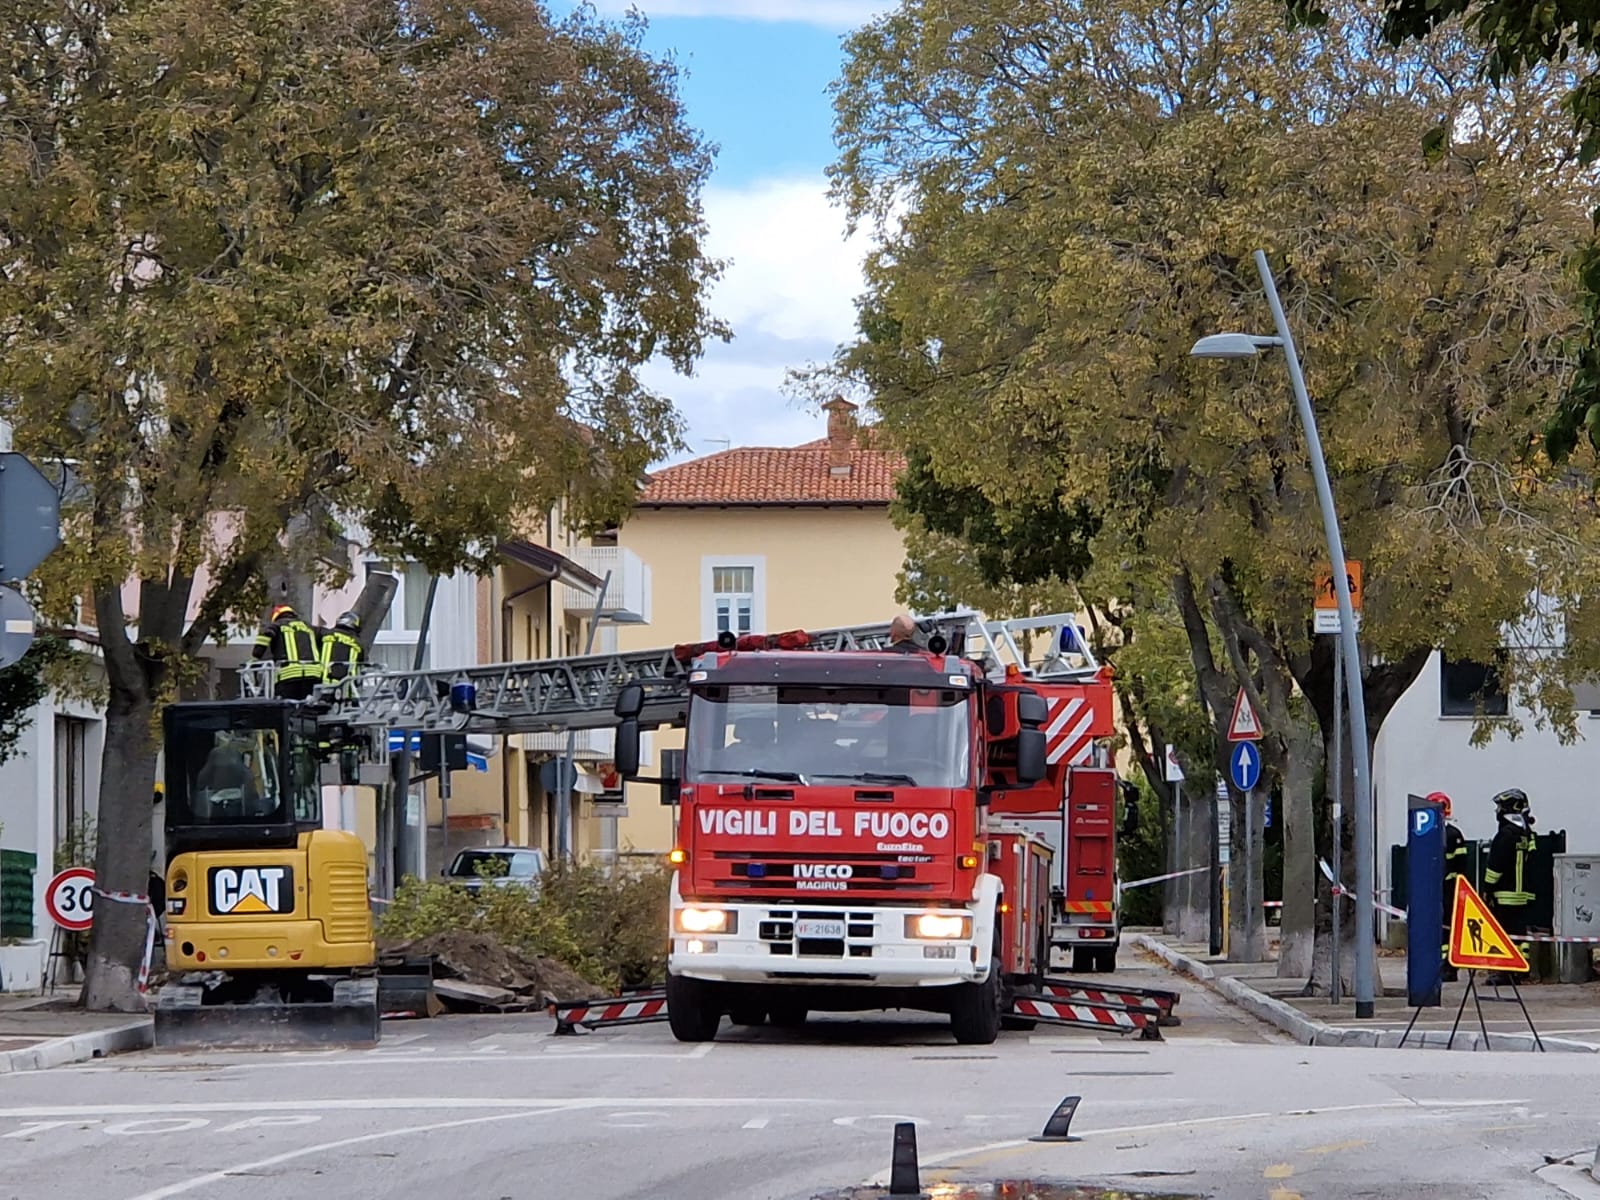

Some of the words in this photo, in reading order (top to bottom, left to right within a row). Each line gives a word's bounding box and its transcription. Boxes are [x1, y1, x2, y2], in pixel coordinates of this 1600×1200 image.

[699, 809, 776, 836] VIGILI
[789, 810, 842, 837] DEL
[854, 812, 949, 839] FUOCO
[1416, 811, 1429, 831] P
[793, 863, 853, 879] IVECO
[215, 868, 284, 913] CAT
[796, 881, 848, 891] MAGIRUS
[60, 885, 95, 912] 30
